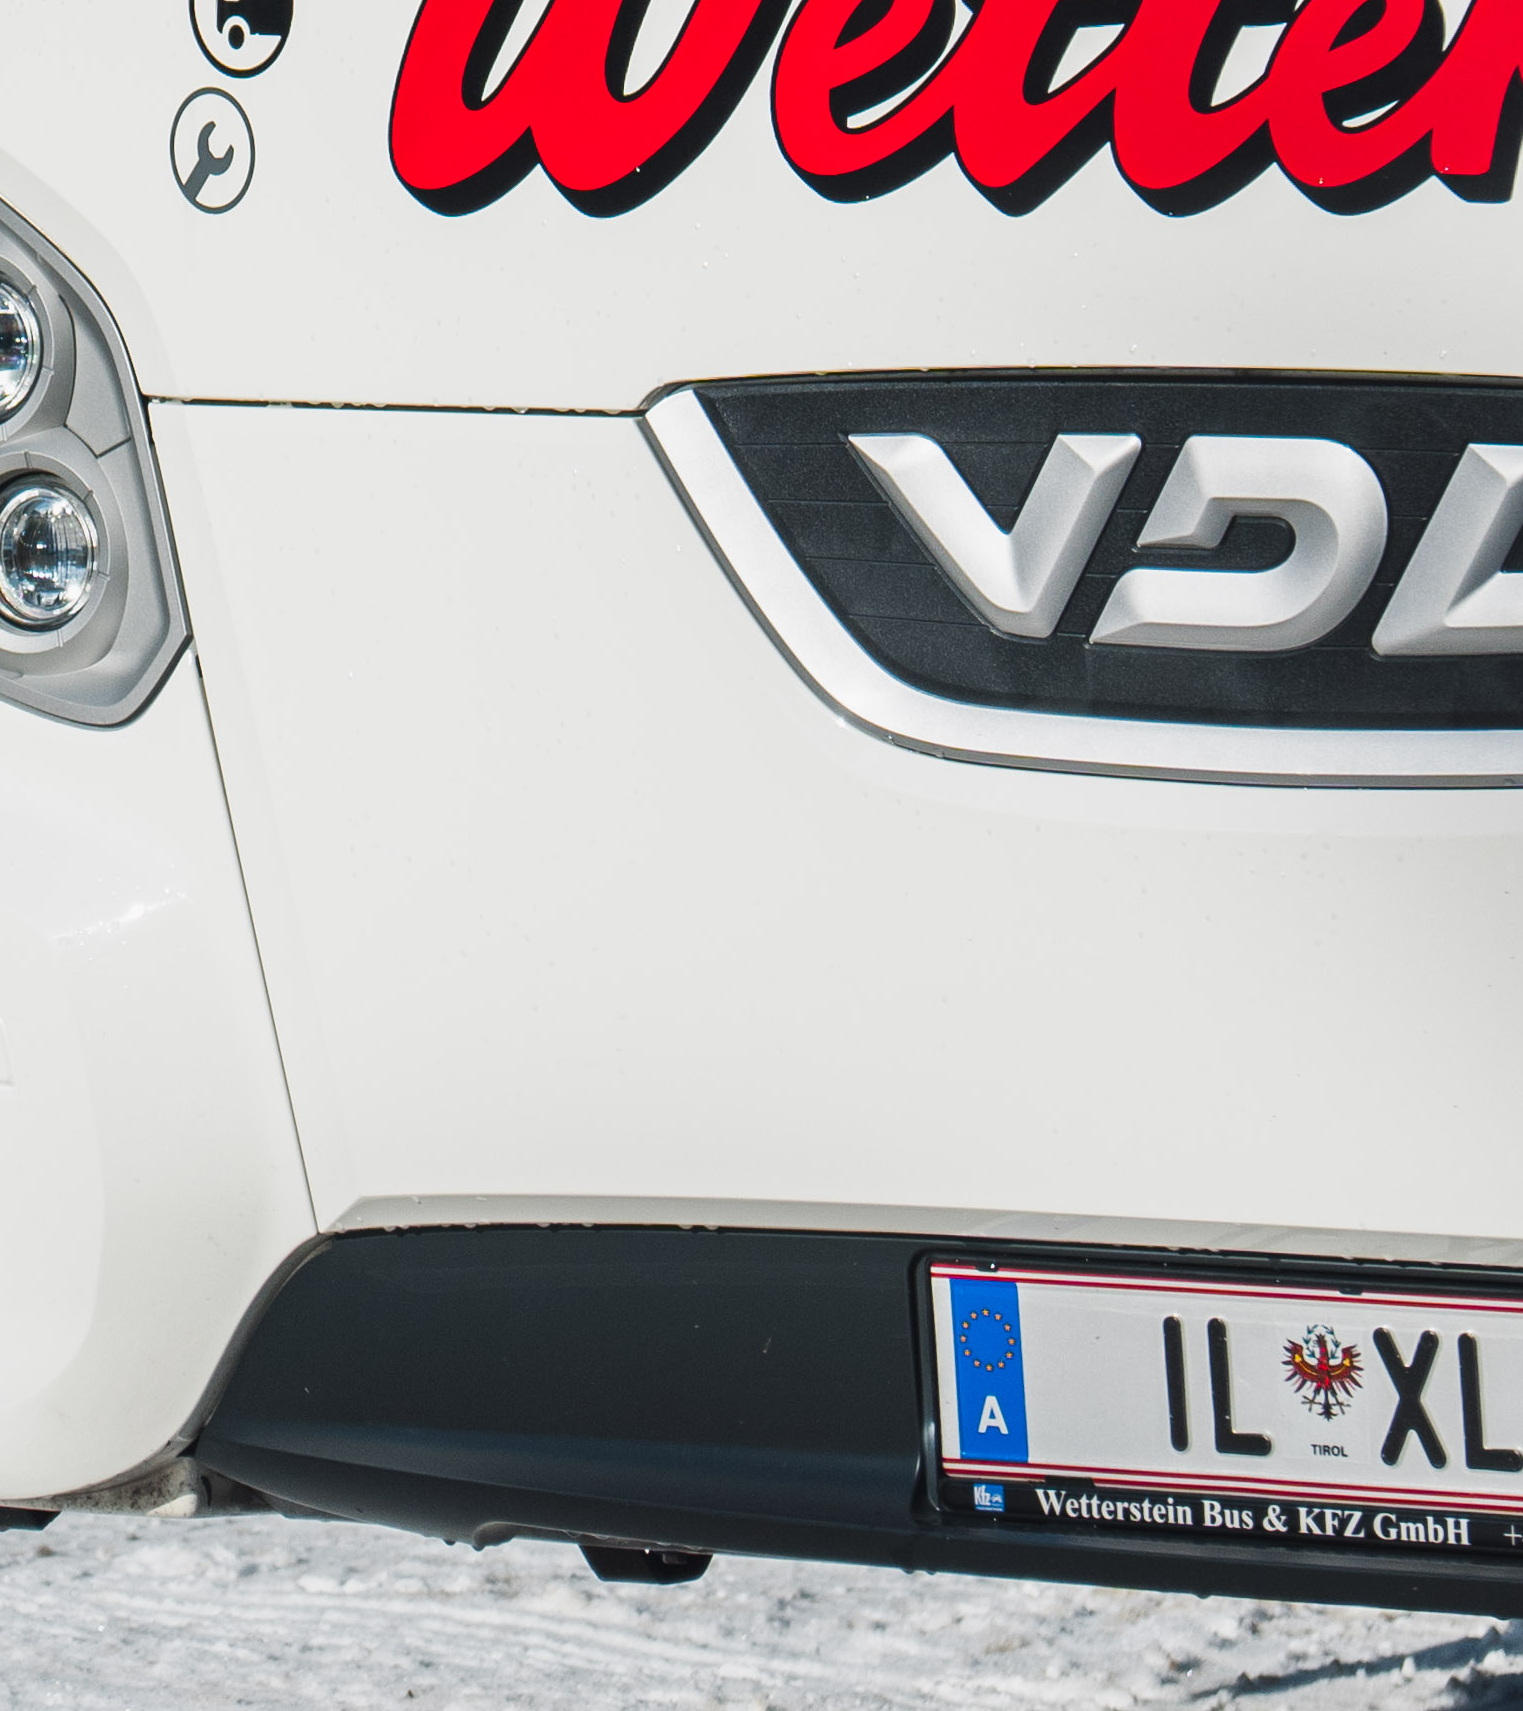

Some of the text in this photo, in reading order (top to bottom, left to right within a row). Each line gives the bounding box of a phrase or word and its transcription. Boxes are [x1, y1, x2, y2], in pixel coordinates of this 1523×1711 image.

[978, 1396, 1009, 1435] A
[1163, 1316, 1272, 1456] IL
[1373, 1328, 1523, 1472] XL
[1311, 1444, 1349, 1458] TIROL
[1035, 1489, 1194, 1526] Wetterstein
[1203, 1500, 1254, 1531] Bus
[1262, 1504, 1288, 1533] &
[1297, 1507, 1365, 1538] KFZ
[1373, 1512, 1471, 1546] GmbH
